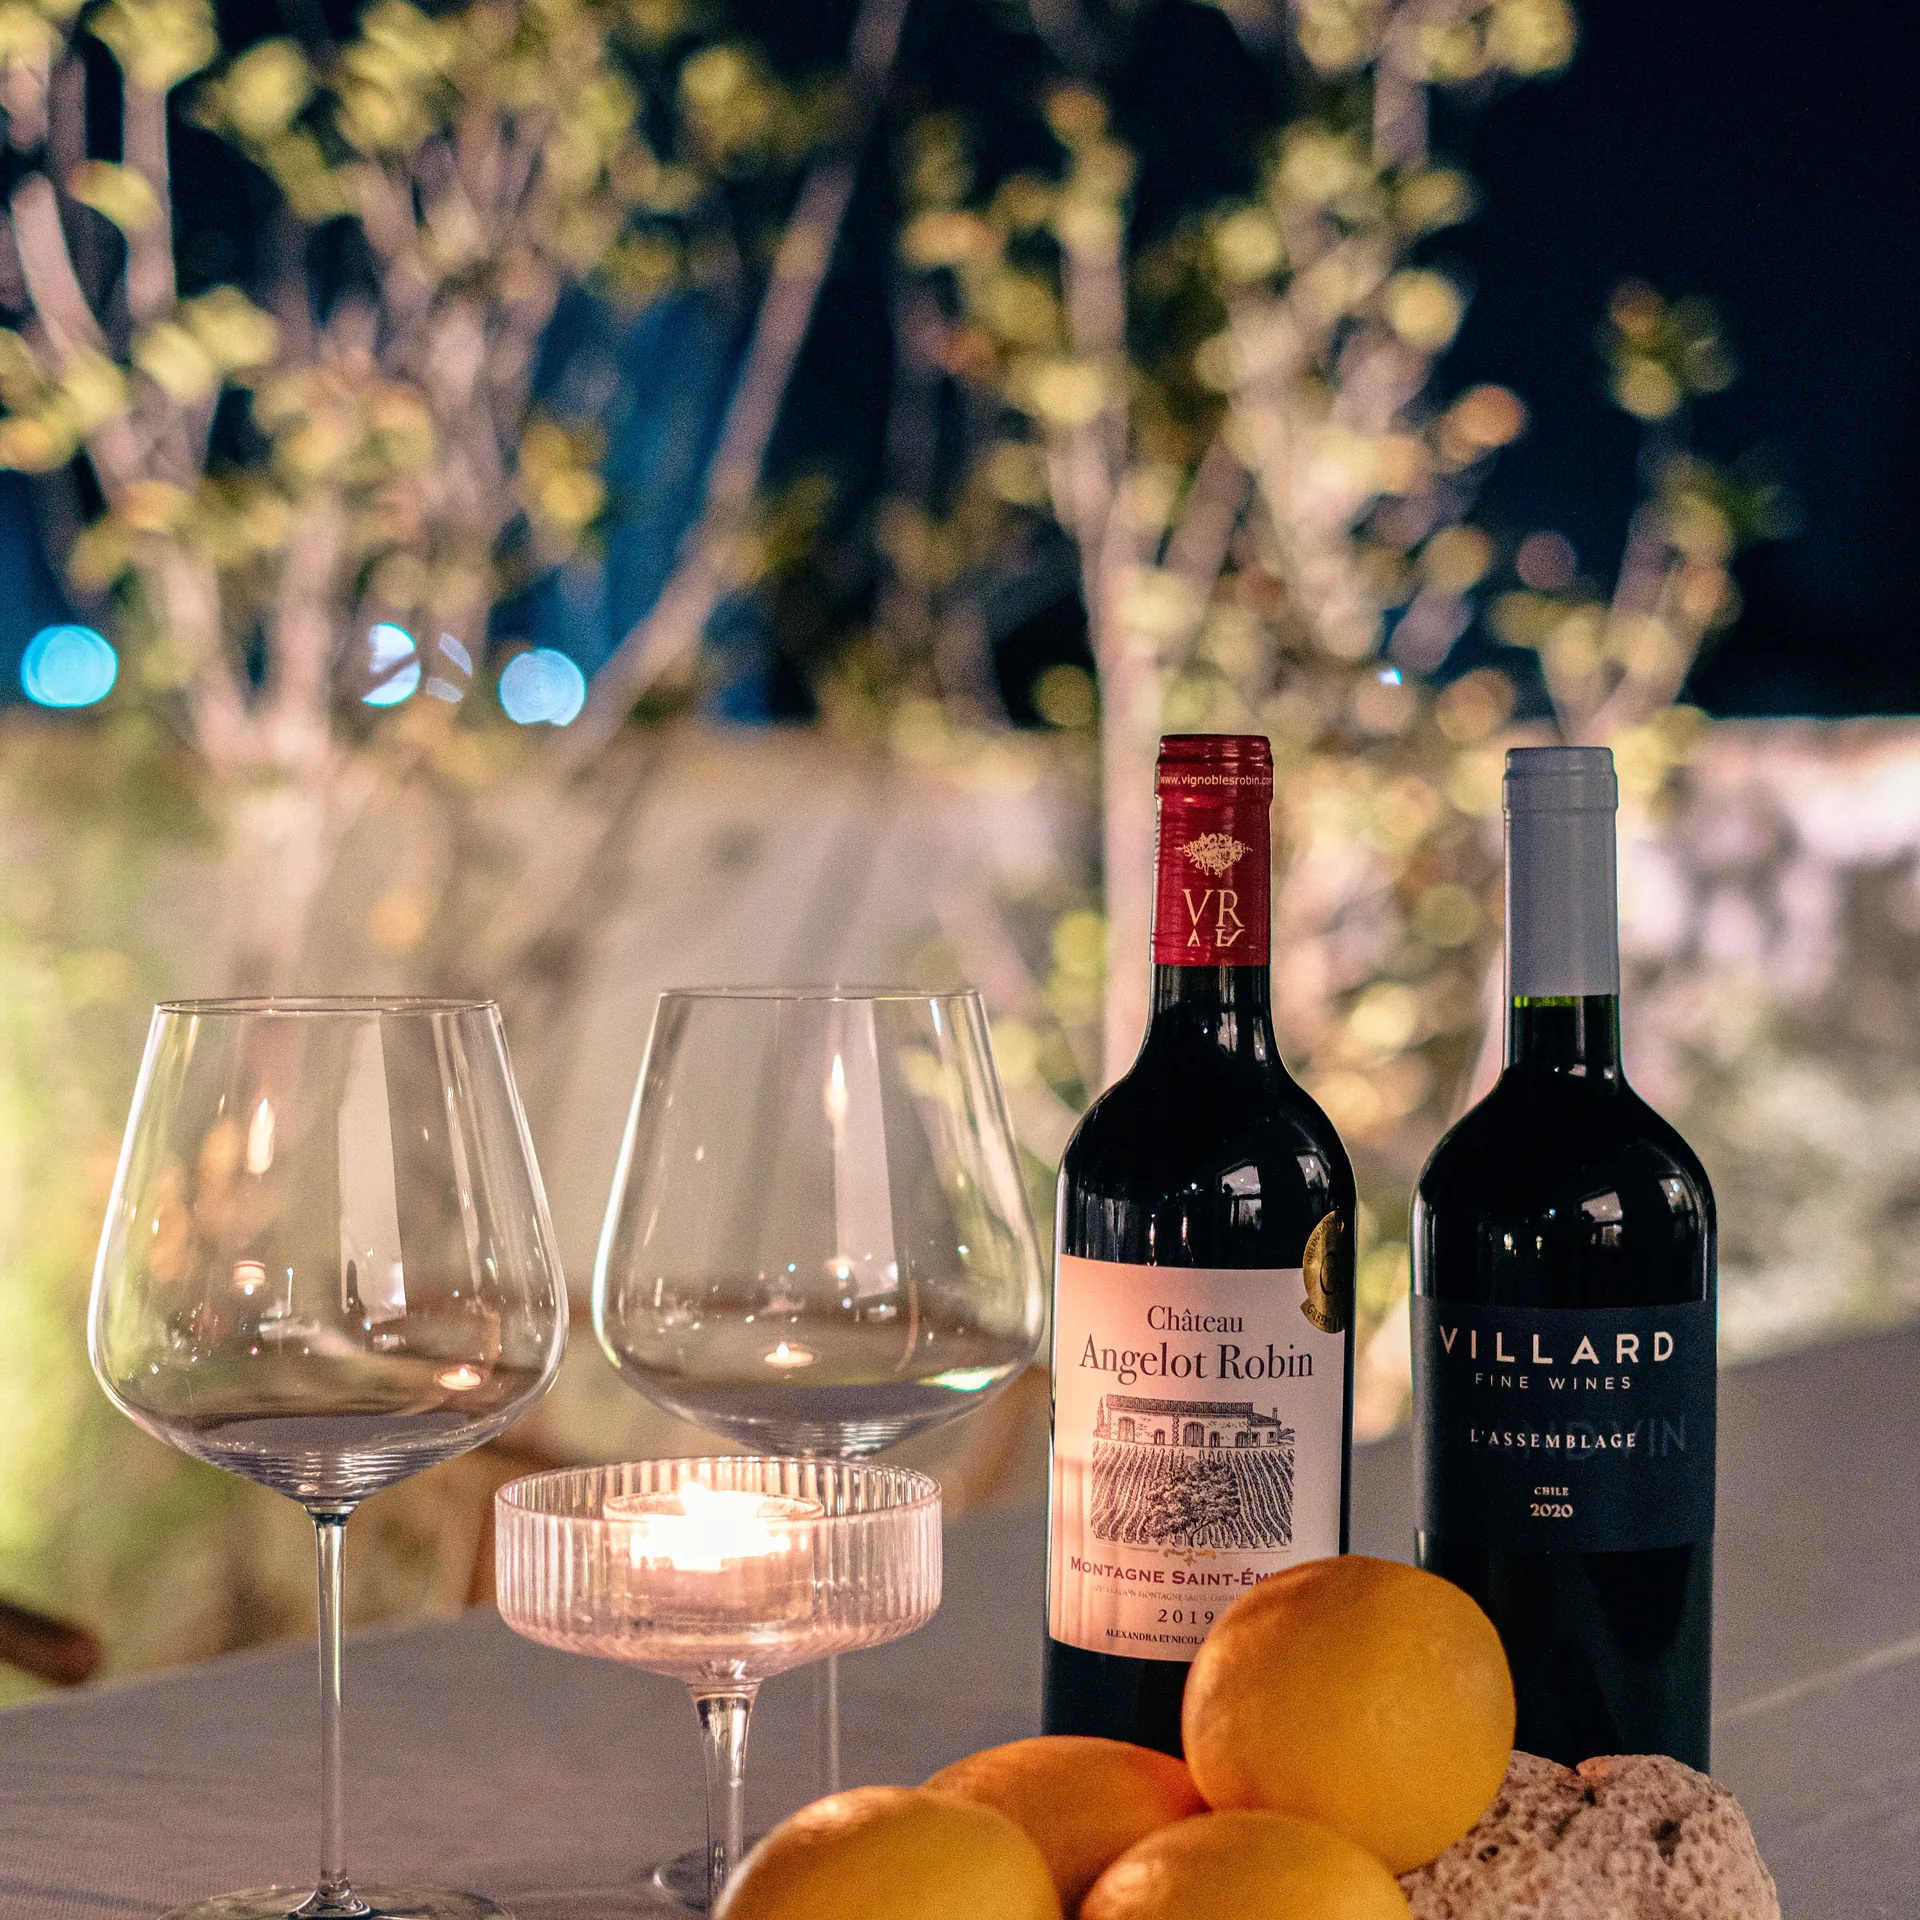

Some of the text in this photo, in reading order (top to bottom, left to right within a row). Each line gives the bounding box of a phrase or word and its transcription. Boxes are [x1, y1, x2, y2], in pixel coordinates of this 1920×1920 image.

[1147, 1304, 1244, 1333] Château
[1439, 1325, 1675, 1365] VILLARD
[1079, 1333, 1315, 1386] Angelot Robin
[1475, 1372, 1632, 1390] FINE WINES
[1471, 1428, 1637, 1449] L'ASSEMBLAGE
[1534, 1486, 1569, 1496] CHILE
[1530, 1502, 1574, 1518] 2020
[1070, 1555, 1271, 1586] MONTAGNE SAINT-ÉM
[1157, 1608, 1215, 1625] 2019
[1105, 1628, 1157, 1642] ALEXANDRA
